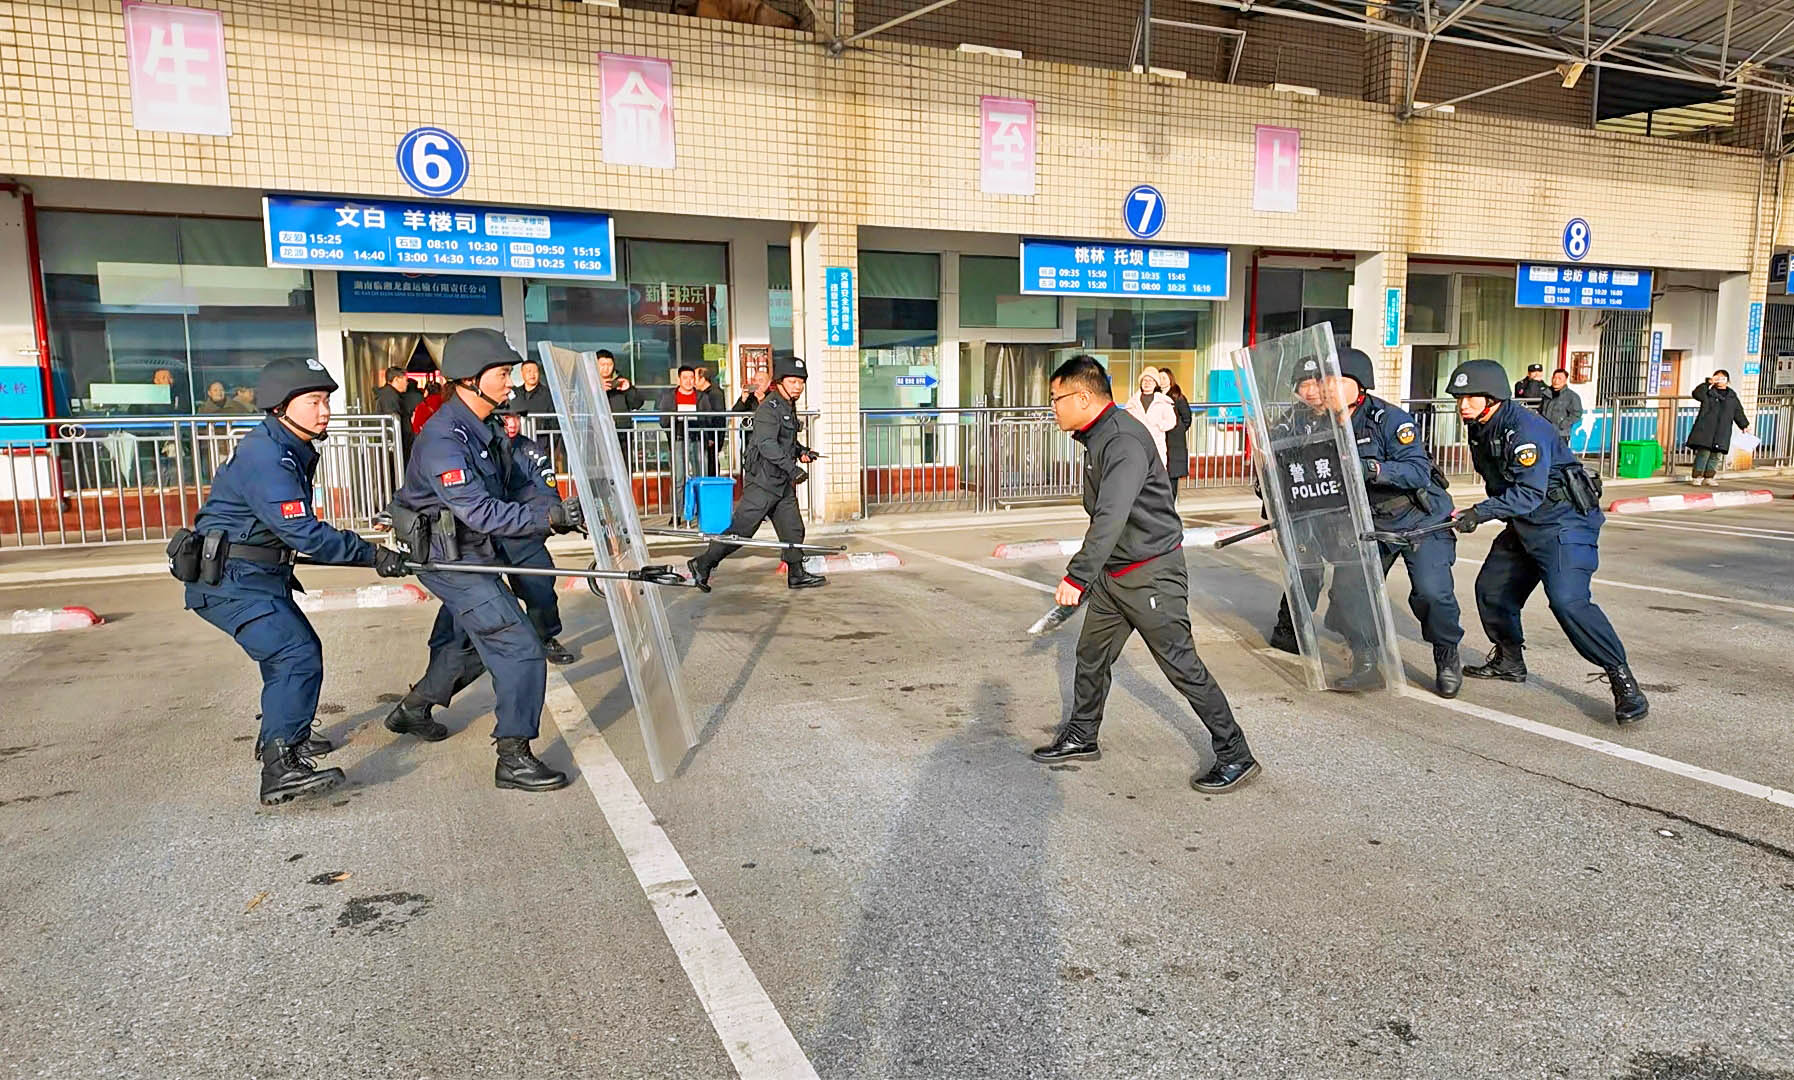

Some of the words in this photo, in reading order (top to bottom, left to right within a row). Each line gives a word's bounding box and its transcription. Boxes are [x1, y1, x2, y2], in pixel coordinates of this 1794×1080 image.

[143, 23, 218, 113] 生
[609, 71, 665, 152] 命
[988, 112, 1027, 176] 至
[1259, 139, 1298, 198] 上
[412, 135, 452, 187] 6
[1135, 192, 1156, 232] 7
[335, 207, 385, 229] 文白
[403, 209, 476, 234] 羊楼司
[309, 234, 342, 245] 15:25
[1570, 222, 1586, 256] 8
[426, 240, 458, 250] 08:10
[468, 242, 498, 252] 10:30
[535, 244, 565, 255] 09:50
[573, 247, 601, 256] 15:15
[310, 249, 344, 260] 09:40
[353, 251, 385, 261] 14:40
[397, 252, 428, 263] 13:00
[433, 254, 464, 264] 14:30
[469, 255, 499, 265] 16:20
[1074, 246, 1105, 264] 桃林
[1113, 248, 1144, 266] 托坝
[537, 259, 565, 269] 10:25
[573, 260, 602, 270] 16:30
[1059, 268, 1080, 277] 09:35
[1088, 269, 1107, 278] 15:50
[1167, 272, 1186, 281] 15:45
[1059, 280, 1080, 288] 09:20
[1088, 281, 1107, 289] 15:20
[1289, 458, 1331, 484] 警察
[1291, 481, 1339, 499] POLICE
